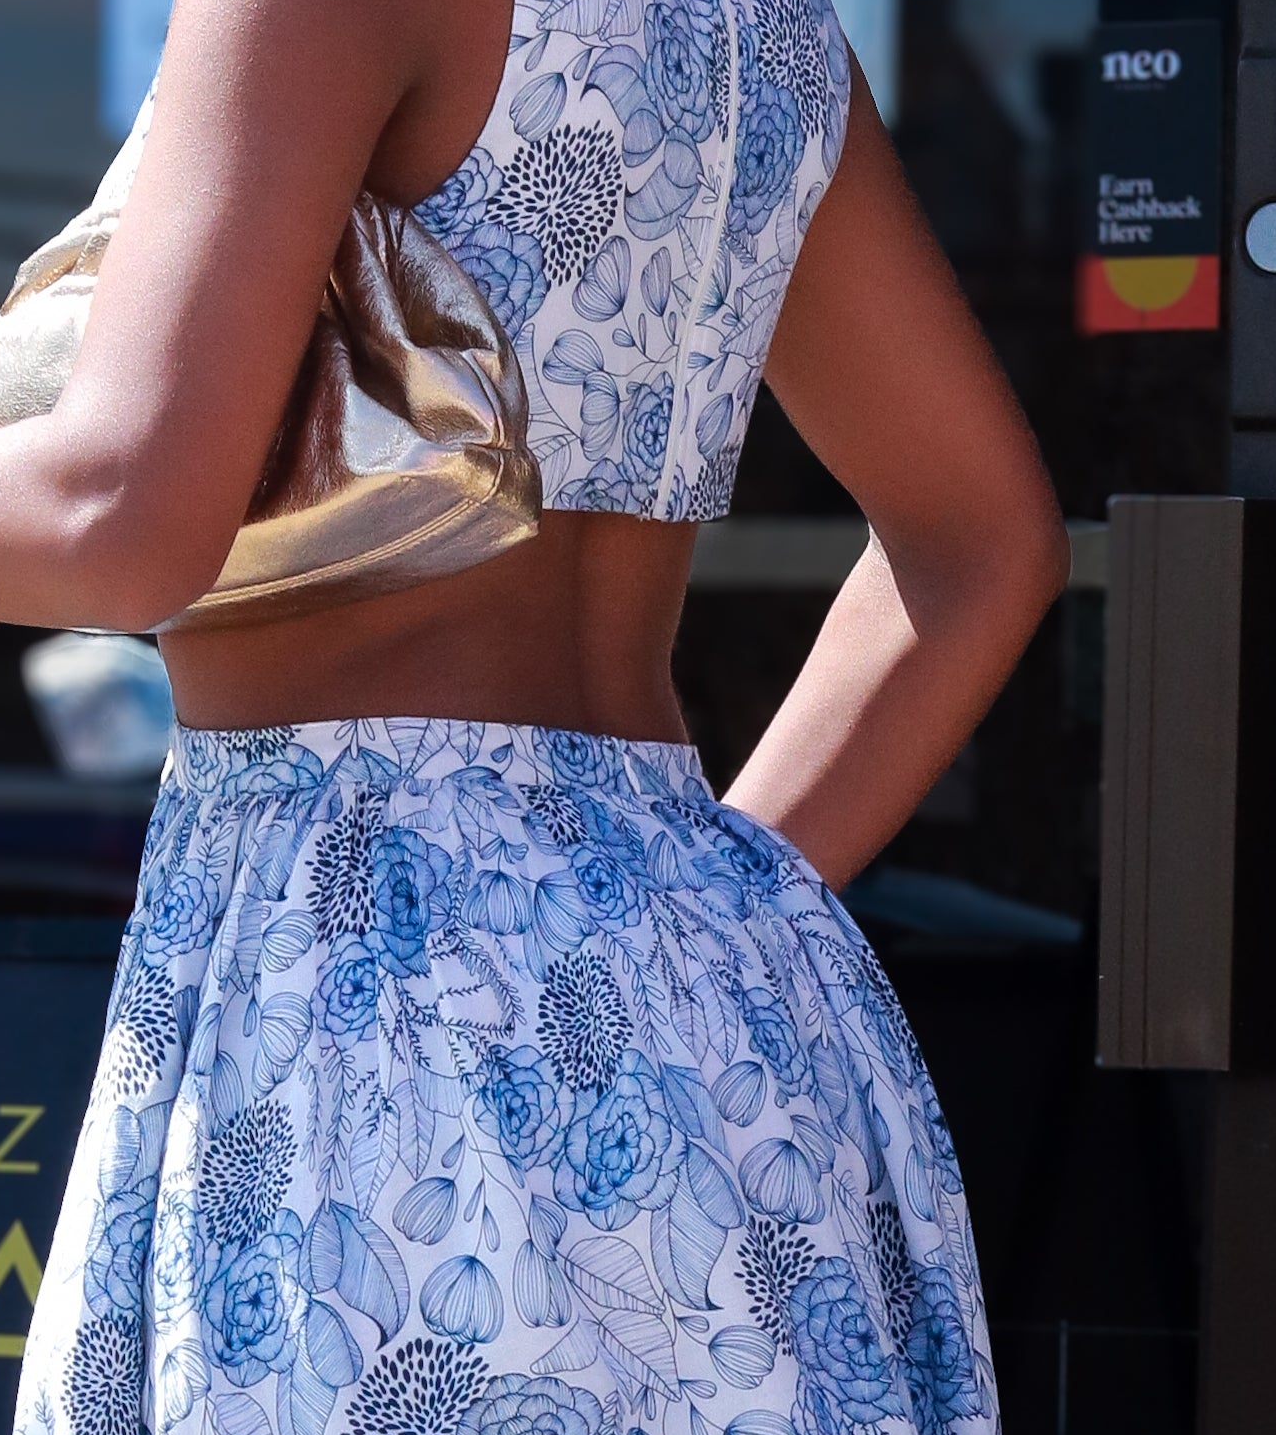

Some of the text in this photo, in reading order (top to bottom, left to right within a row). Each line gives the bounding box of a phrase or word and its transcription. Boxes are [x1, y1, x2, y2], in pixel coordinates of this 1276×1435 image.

[1101, 49, 1181, 81] neo
[1099, 174, 1153, 197] Earn
[1098, 195, 1201, 221] Cashback
[1099, 221, 1152, 244] Here
